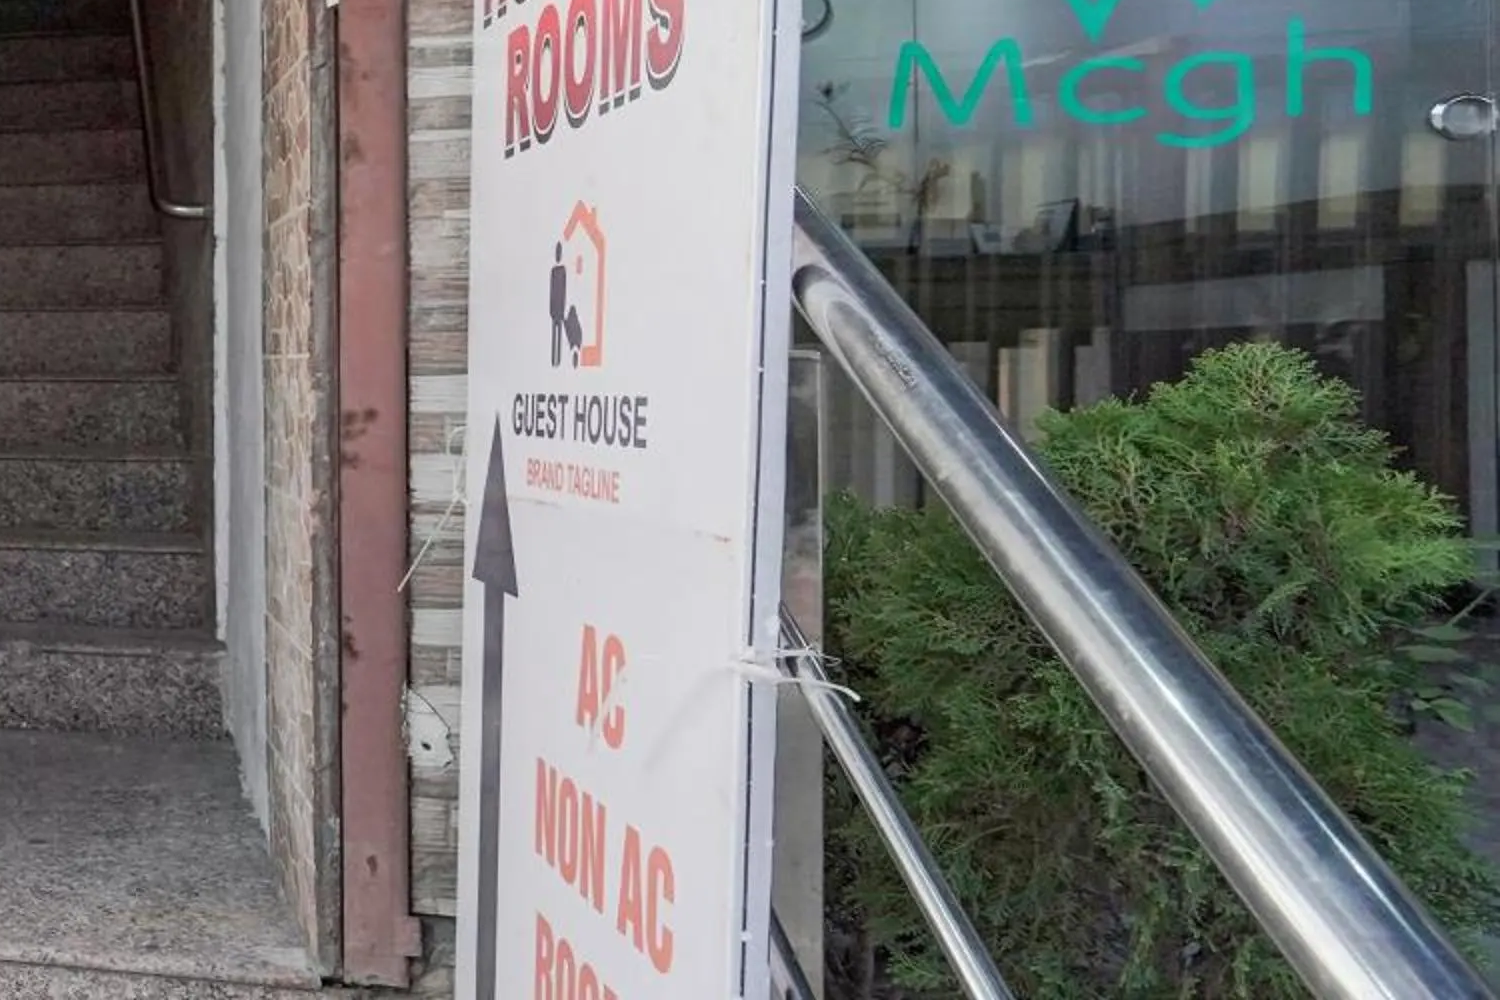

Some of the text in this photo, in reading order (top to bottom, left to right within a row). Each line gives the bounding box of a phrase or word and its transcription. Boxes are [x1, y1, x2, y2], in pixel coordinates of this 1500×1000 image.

[888, 16, 1372, 148] Mcgh
[512, 392, 648, 449] GUEST HOUSE
[526, 457, 621, 504] BRAND TAGLINE
[575, 623, 626, 750] AC
[535, 756, 675, 975] NON AC
